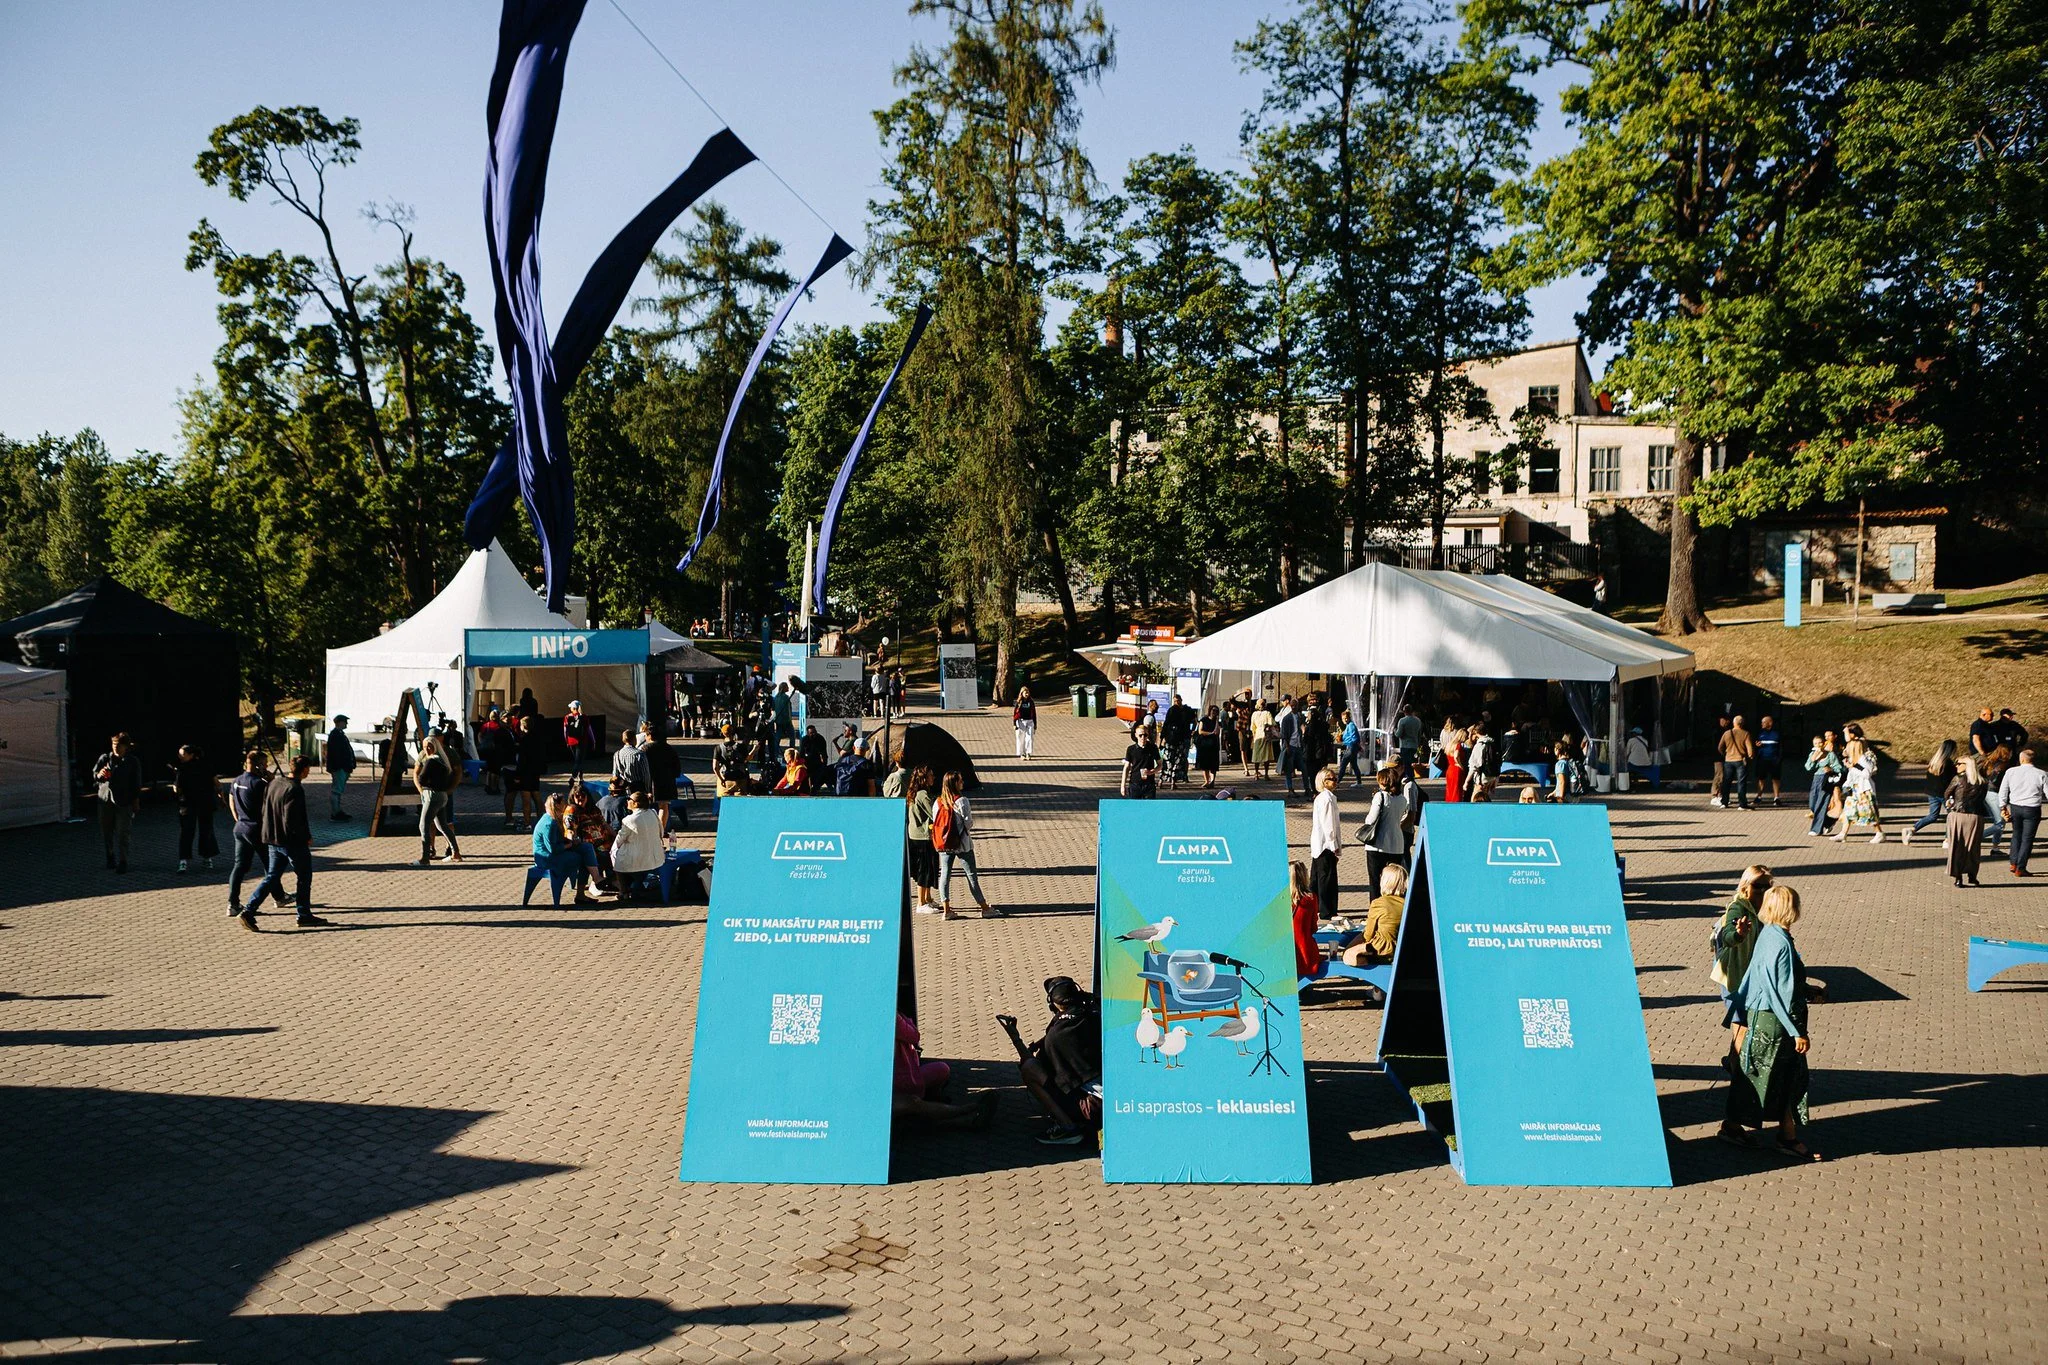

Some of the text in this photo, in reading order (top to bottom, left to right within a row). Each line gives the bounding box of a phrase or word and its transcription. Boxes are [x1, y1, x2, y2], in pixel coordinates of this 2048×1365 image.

[532, 635, 589, 658] INFO
[784, 840, 835, 851] LAMPA
[1168, 844, 1219, 855] LAMPA
[1496, 846, 1547, 857] LAMPA
[789, 871, 828, 879] festivāls
[1177, 874, 1216, 883] festivāls
[1508, 876, 1547, 885] festivāls
[723, 917, 884, 932] CIK TU MAKSĀTU PAR BIĻETI?
[1454, 922, 1612, 937] CIK TU MAKSĀTU PAR BIĻETI?
[733, 931, 871, 945] ZIEDO, LAI TURPINĀTOS!
[1467, 936, 1602, 949] ZIEDO, LAI TURPINĀTOS!
[1115, 1099, 1134, 1113] Lai
[1137, 1102, 1203, 1116] saprastos
[1217, 1099, 1296, 1114] ieklausies!
[747, 1118, 829, 1129] VAIRĀK INFORMĀCIJAS
[1520, 1122, 1602, 1132] VAIRĀK INFORMĀCIJAS
[749, 1130, 827, 1140] www.festivalslampa.lv
[1524, 1133, 1602, 1142] www.festivalslampa.lv
